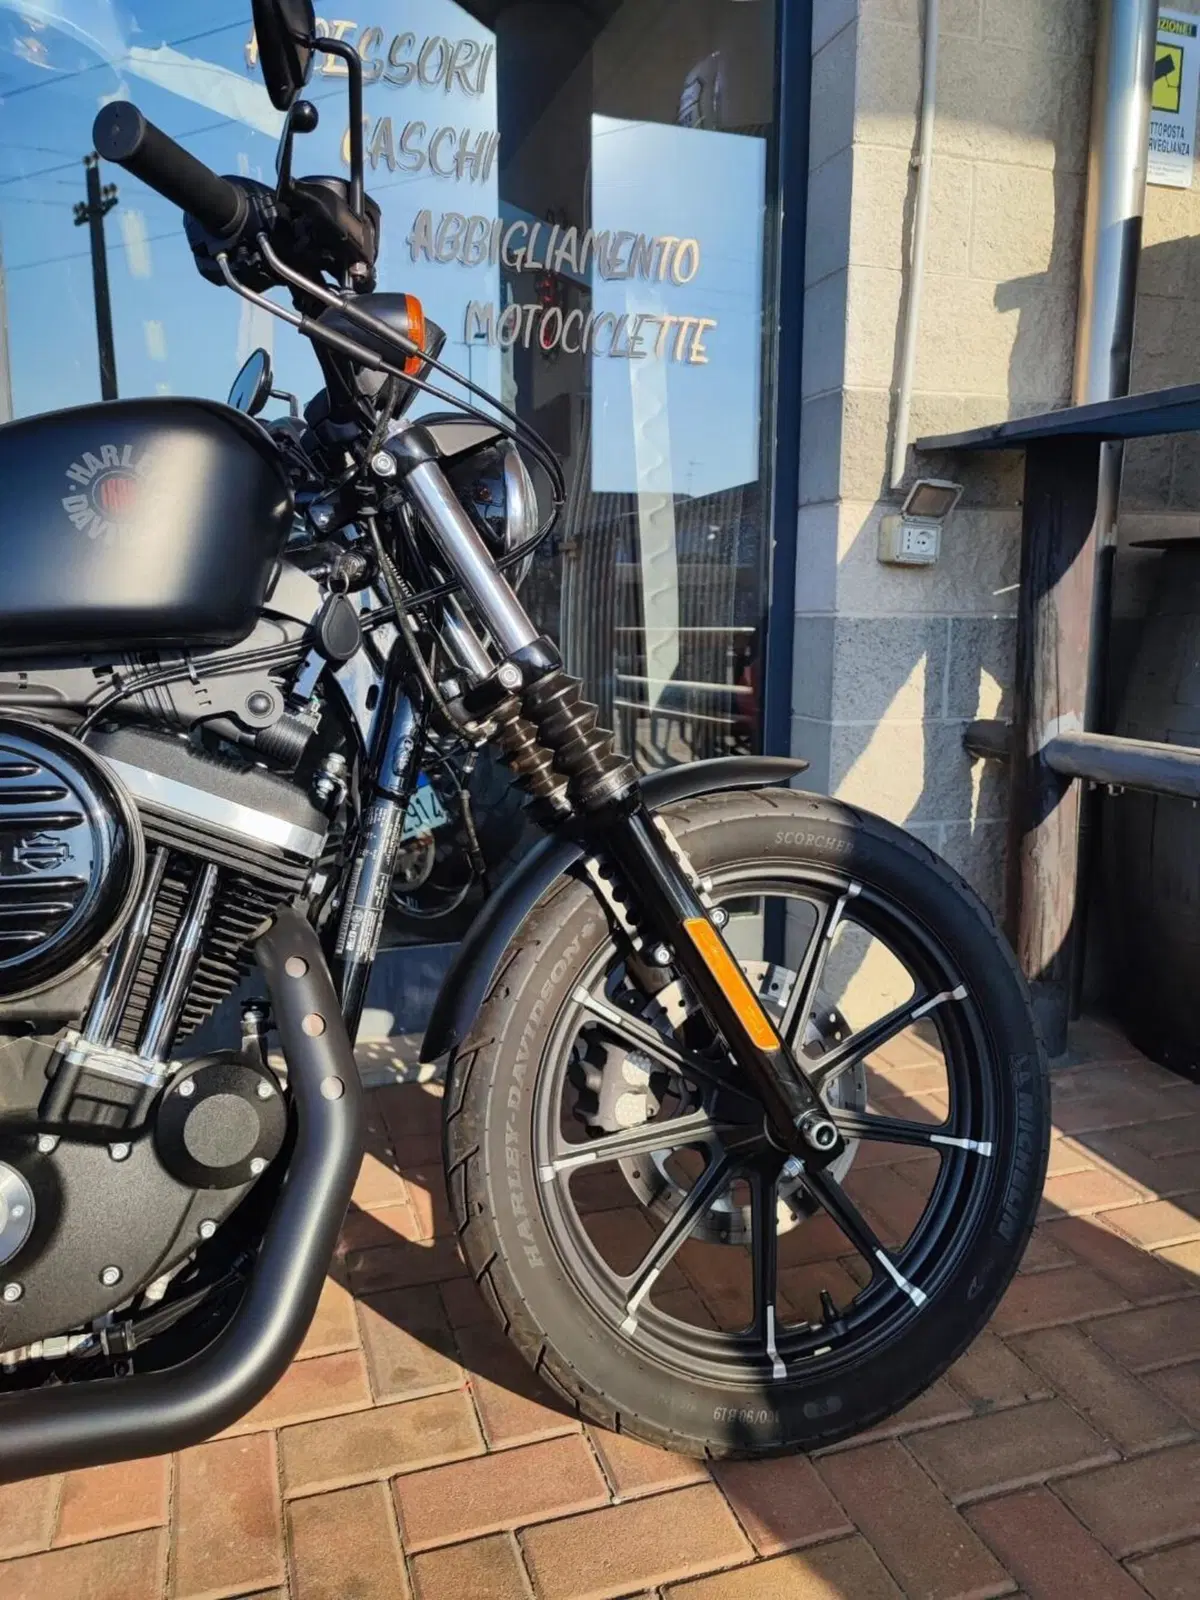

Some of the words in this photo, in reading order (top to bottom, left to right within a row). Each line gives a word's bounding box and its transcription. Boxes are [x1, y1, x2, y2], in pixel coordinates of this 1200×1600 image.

[245, 17, 494, 96] ESSORI
[1149, 138, 1190, 156] RVEGLIANZA
[1150, 122, 1185, 139] TTOPOSTA
[406, 209, 701, 286] ABBIGLIAMENTO
[464, 300, 717, 364] MOTOCICLETTE
